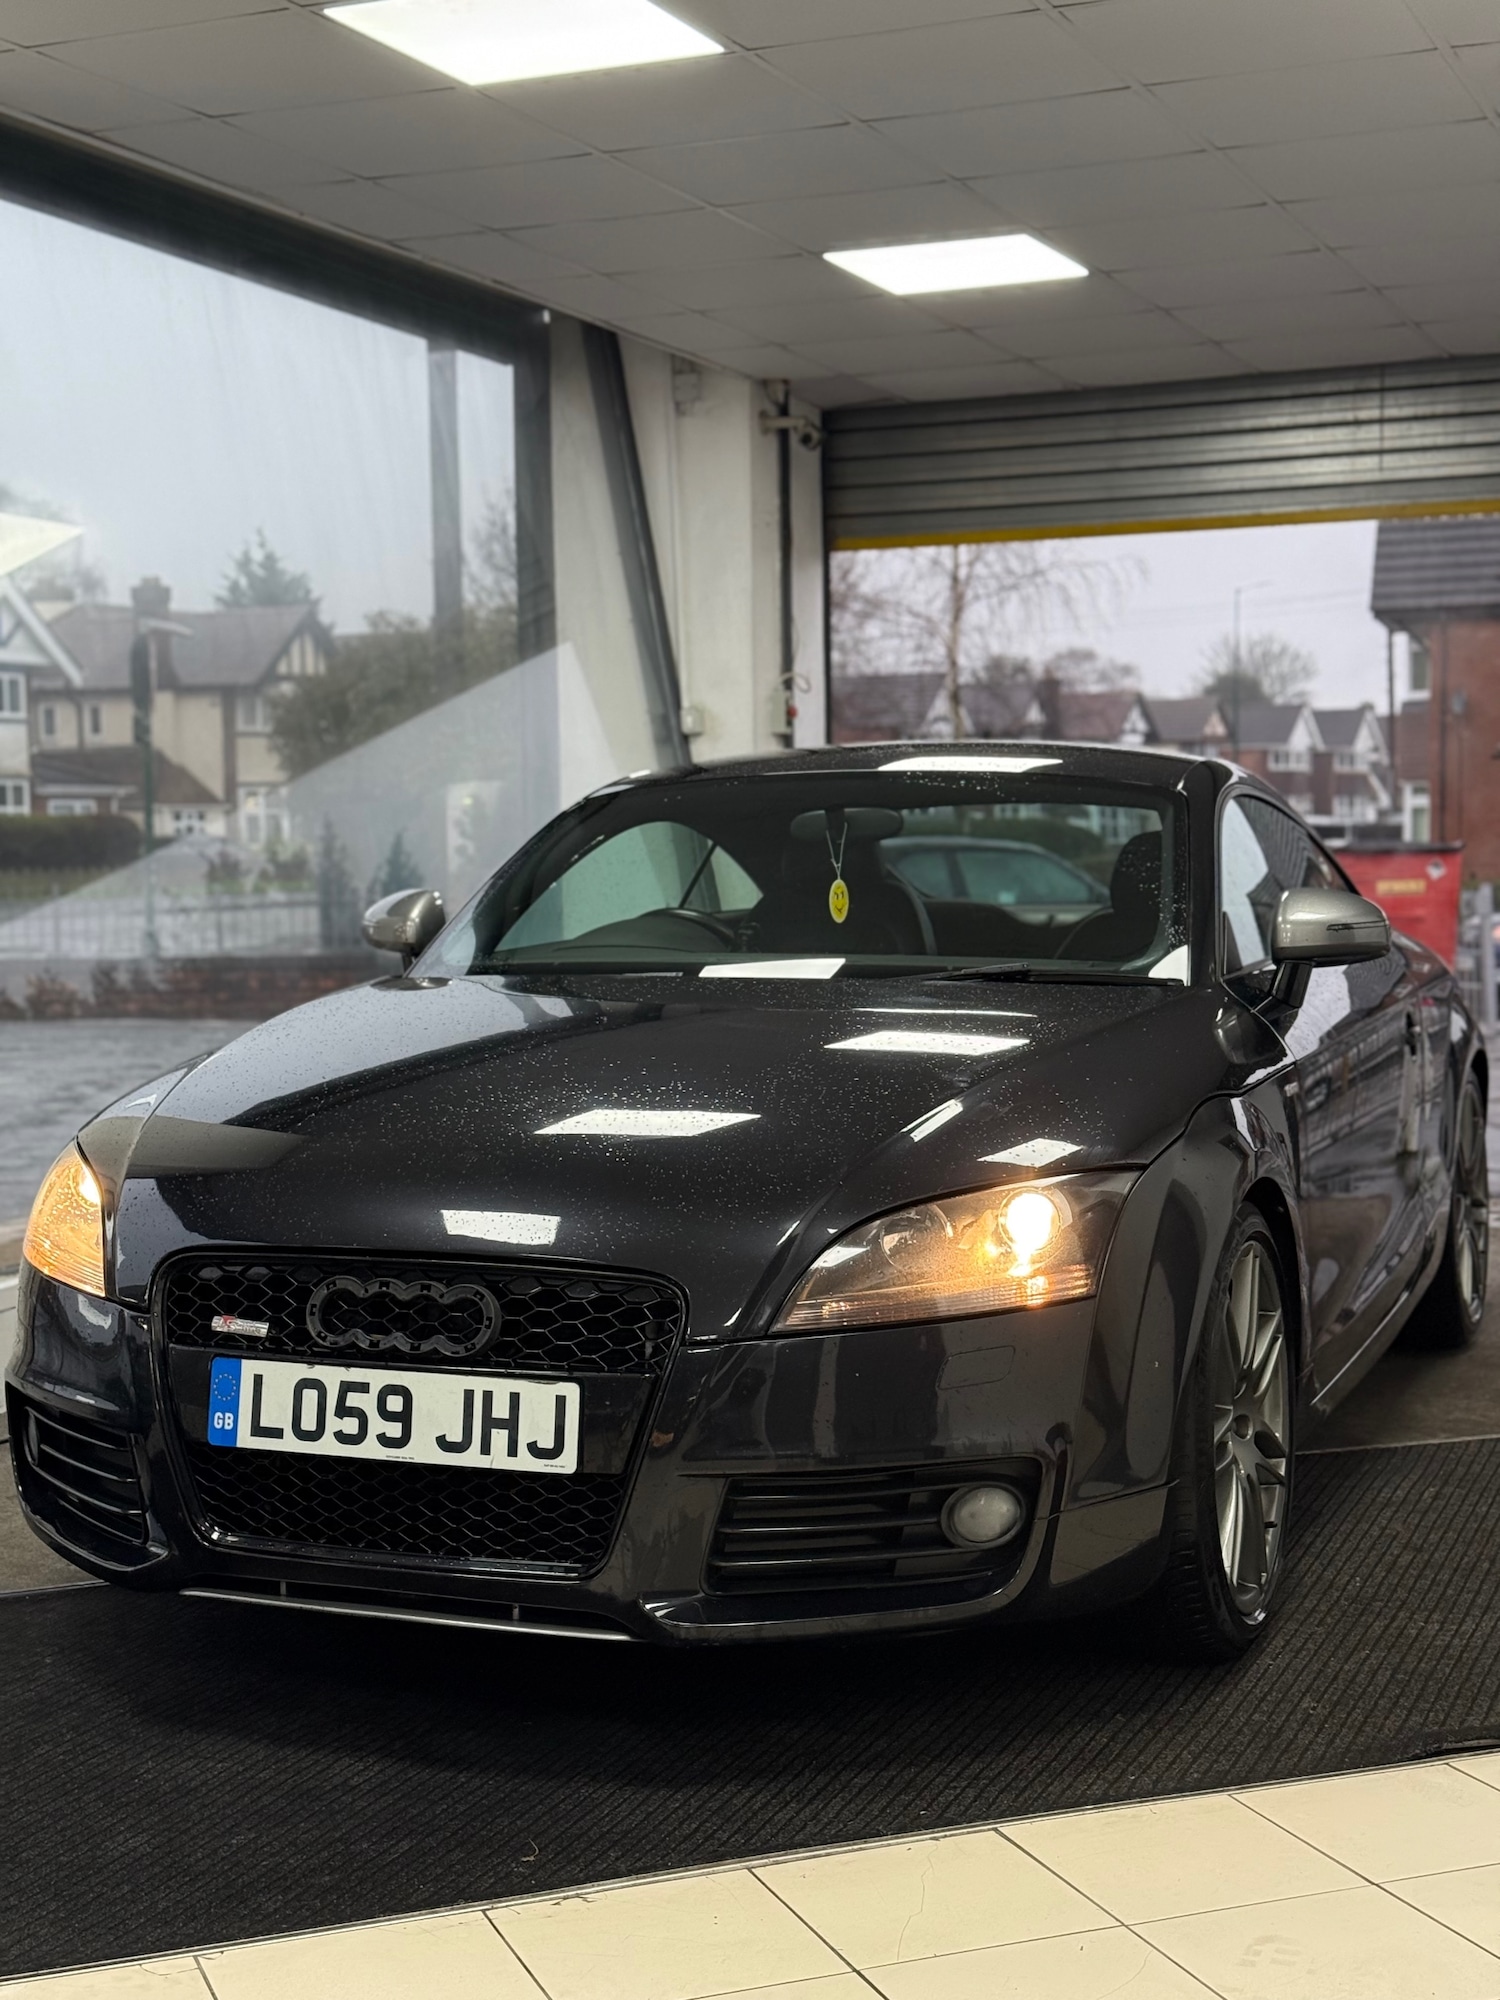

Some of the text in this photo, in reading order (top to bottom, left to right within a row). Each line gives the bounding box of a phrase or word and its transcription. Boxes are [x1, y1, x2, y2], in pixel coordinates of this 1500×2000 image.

[213, 1411, 234, 1430] GB
[250, 1373, 567, 1460] LO59 JHJ
